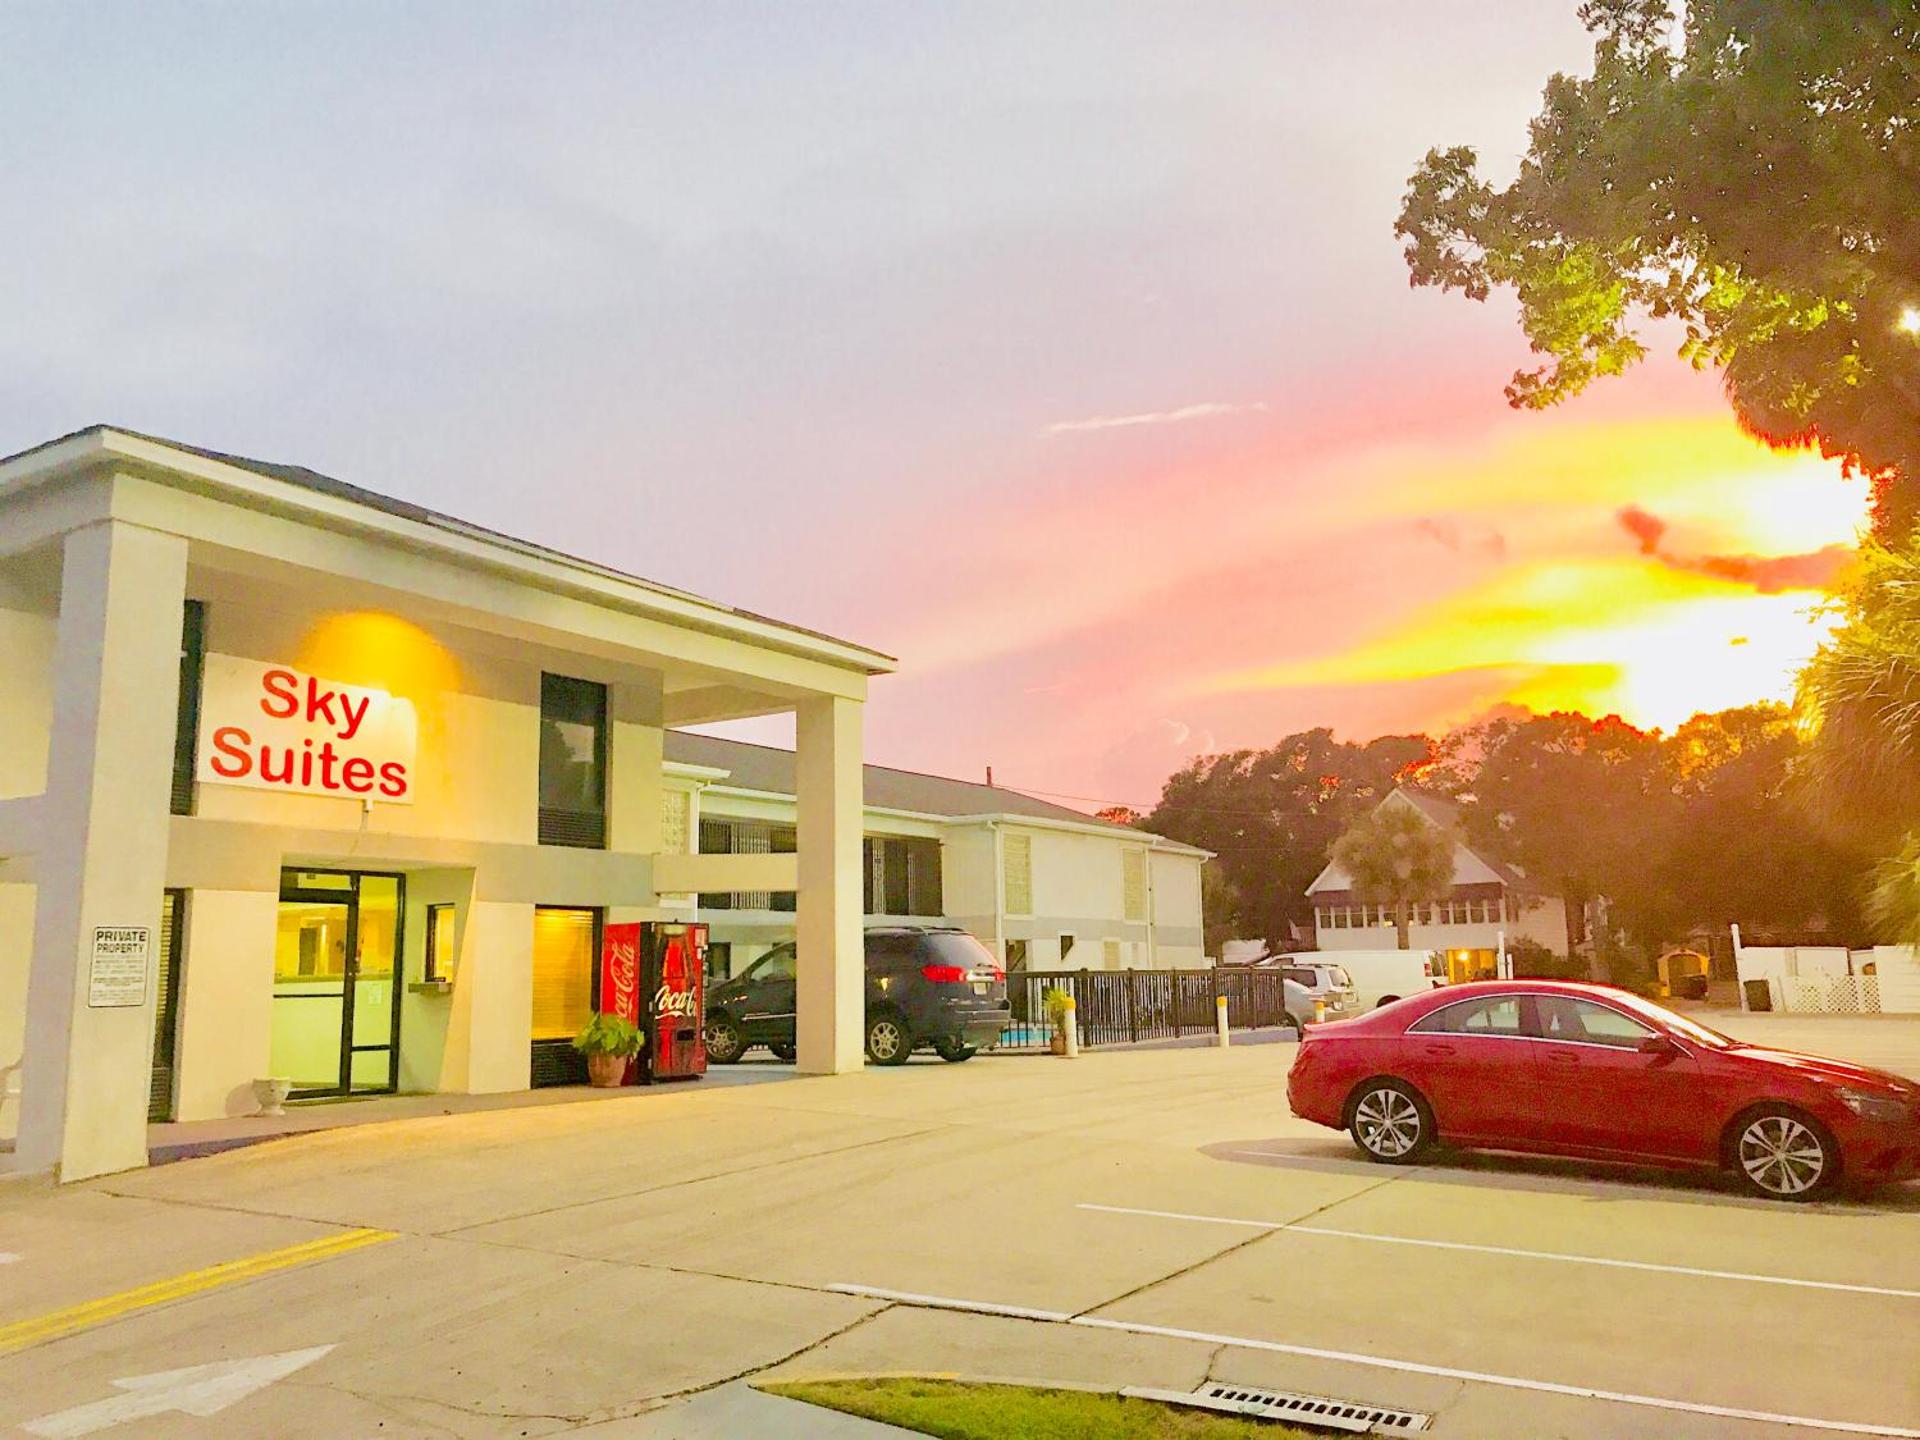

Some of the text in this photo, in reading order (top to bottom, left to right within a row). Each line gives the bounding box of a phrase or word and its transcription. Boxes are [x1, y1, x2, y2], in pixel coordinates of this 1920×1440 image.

[260, 670, 369, 740] Sky
[211, 727, 407, 797] Suites
[96, 931, 147, 942] PRIVATE
[96, 943, 144, 953] PROPERTY
